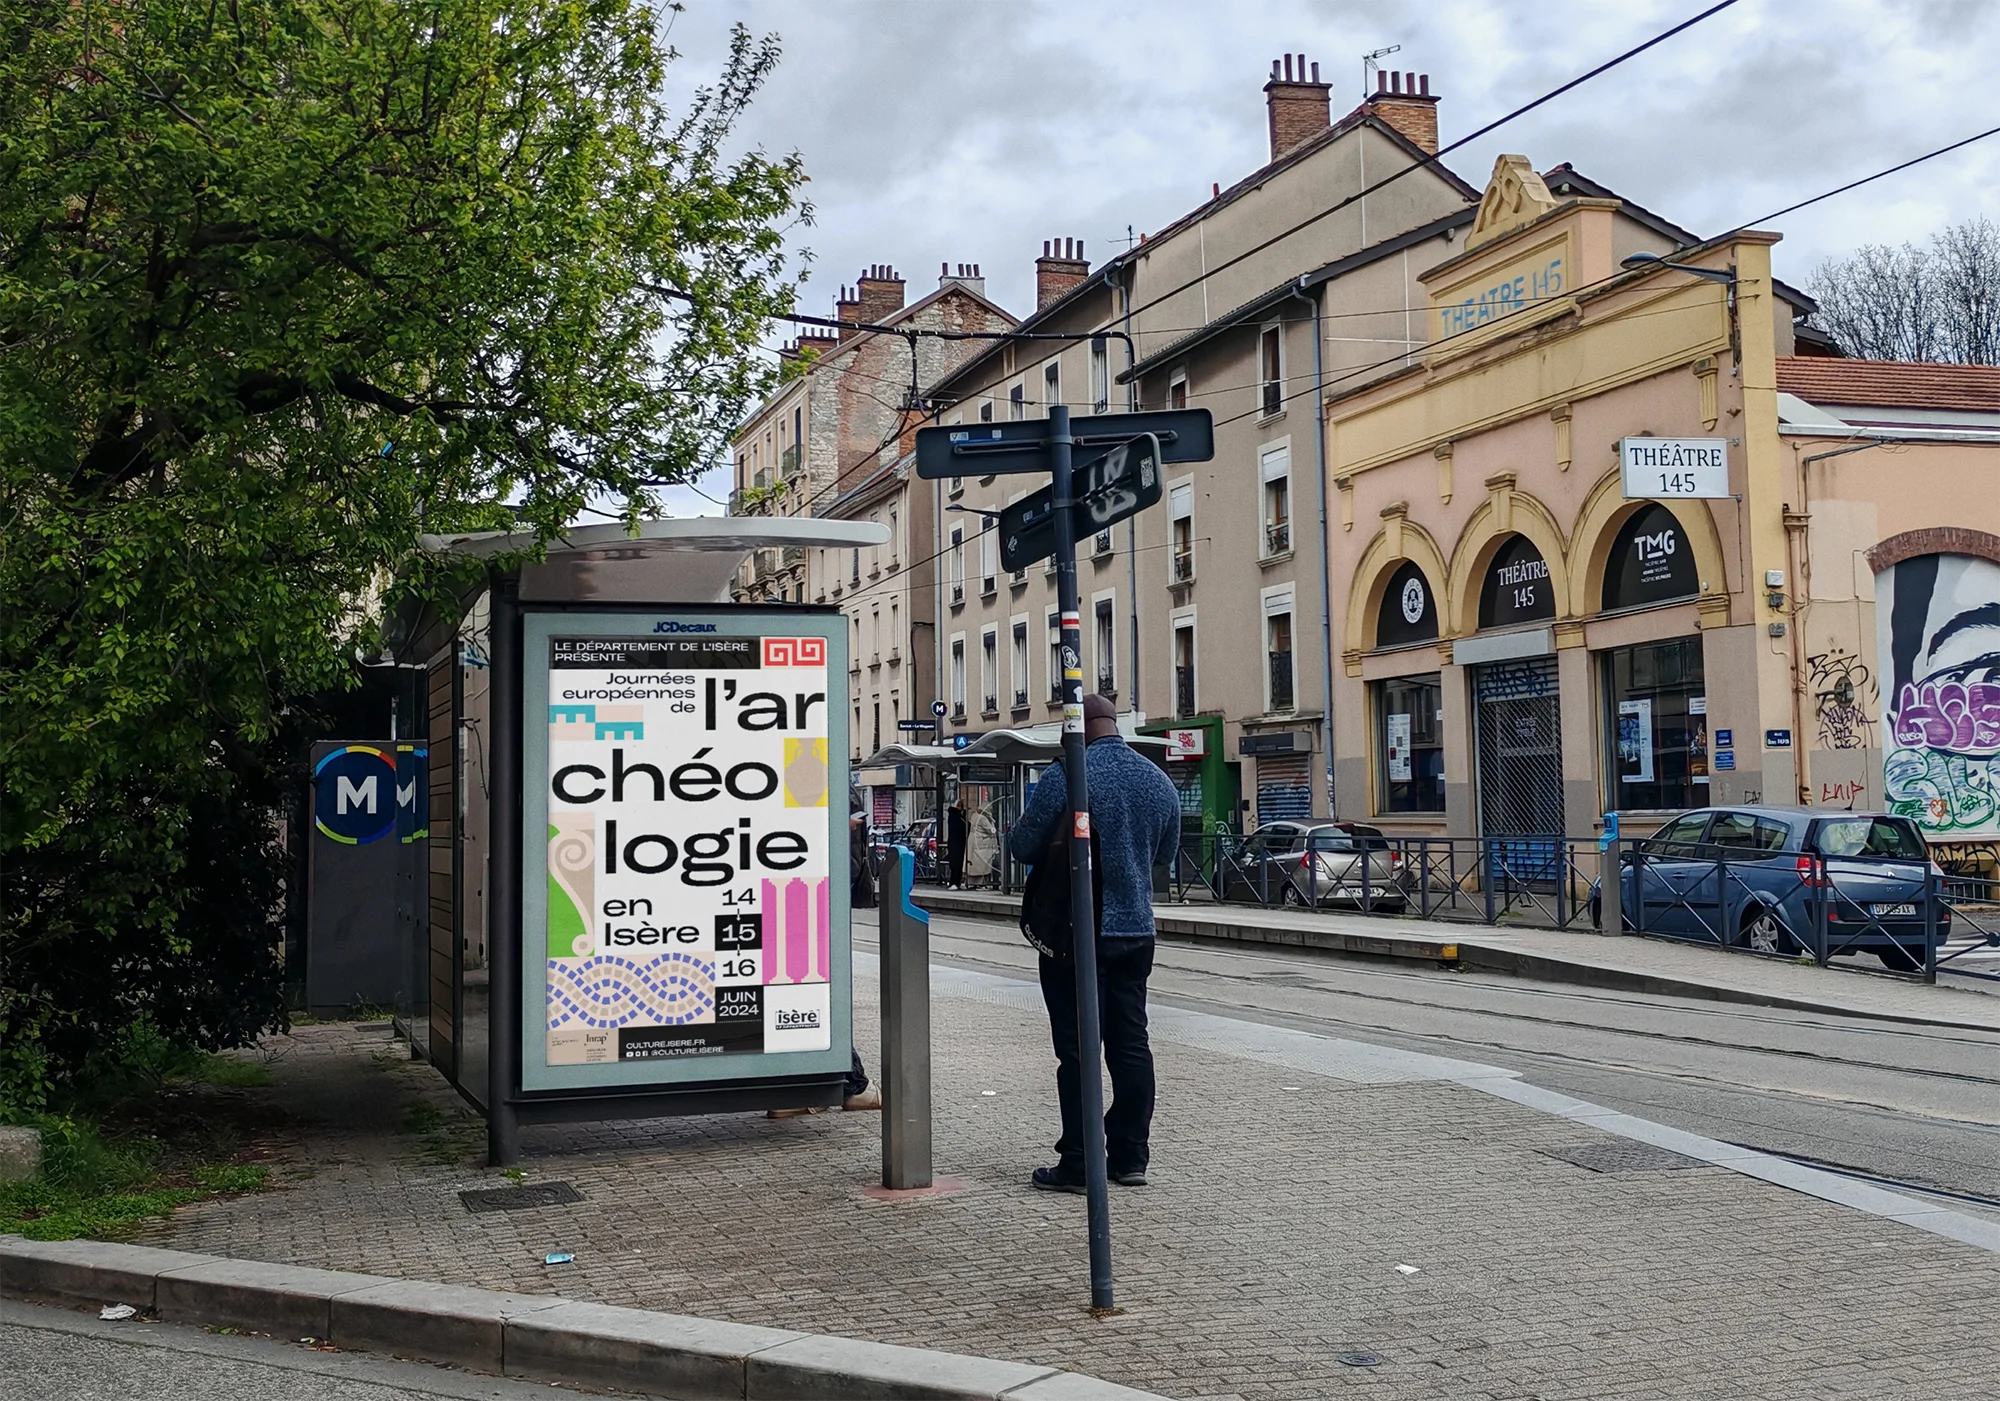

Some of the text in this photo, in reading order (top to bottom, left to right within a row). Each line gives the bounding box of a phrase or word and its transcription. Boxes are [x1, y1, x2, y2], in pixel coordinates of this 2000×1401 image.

[1532, 260, 1562, 299] 145
[1630, 443, 1722, 467] THÉÂTRE
[1658, 472, 1696, 493] 145
[1634, 529, 1676, 561] TMG
[1497, 559, 1549, 586] THÉÂTRE
[1513, 586, 1535, 609] 145
[653, 622, 717, 633] JCDecaux
[554, 640, 749, 652] LE DÉPARTEMENT DE L'ISÈRE
[554, 652, 626, 662] PRÉSENTE
[606, 672, 696, 685] Journées
[562, 686, 696, 701] européennes
[670, 700, 696, 713] de
[936, 705, 944, 713] M
[552, 747, 779, 804] chéo
[337, 776, 377, 815] M
[605, 818, 809, 887] logie
[722, 888, 756, 906] 14
[602, 898, 653, 917] en
[604, 922, 700, 946] Isère
[722, 923, 756, 942] 15
[722, 959, 756, 978] 16
[720, 991, 756, 1004] JUIN
[719, 1004, 759, 1017] 2024
[778, 1009, 818, 1024] isère
[626, 1039, 706, 1050] CULTURE.ISERE.FR
[651, 1046, 724, 1057] @CULTURE.ISERE
